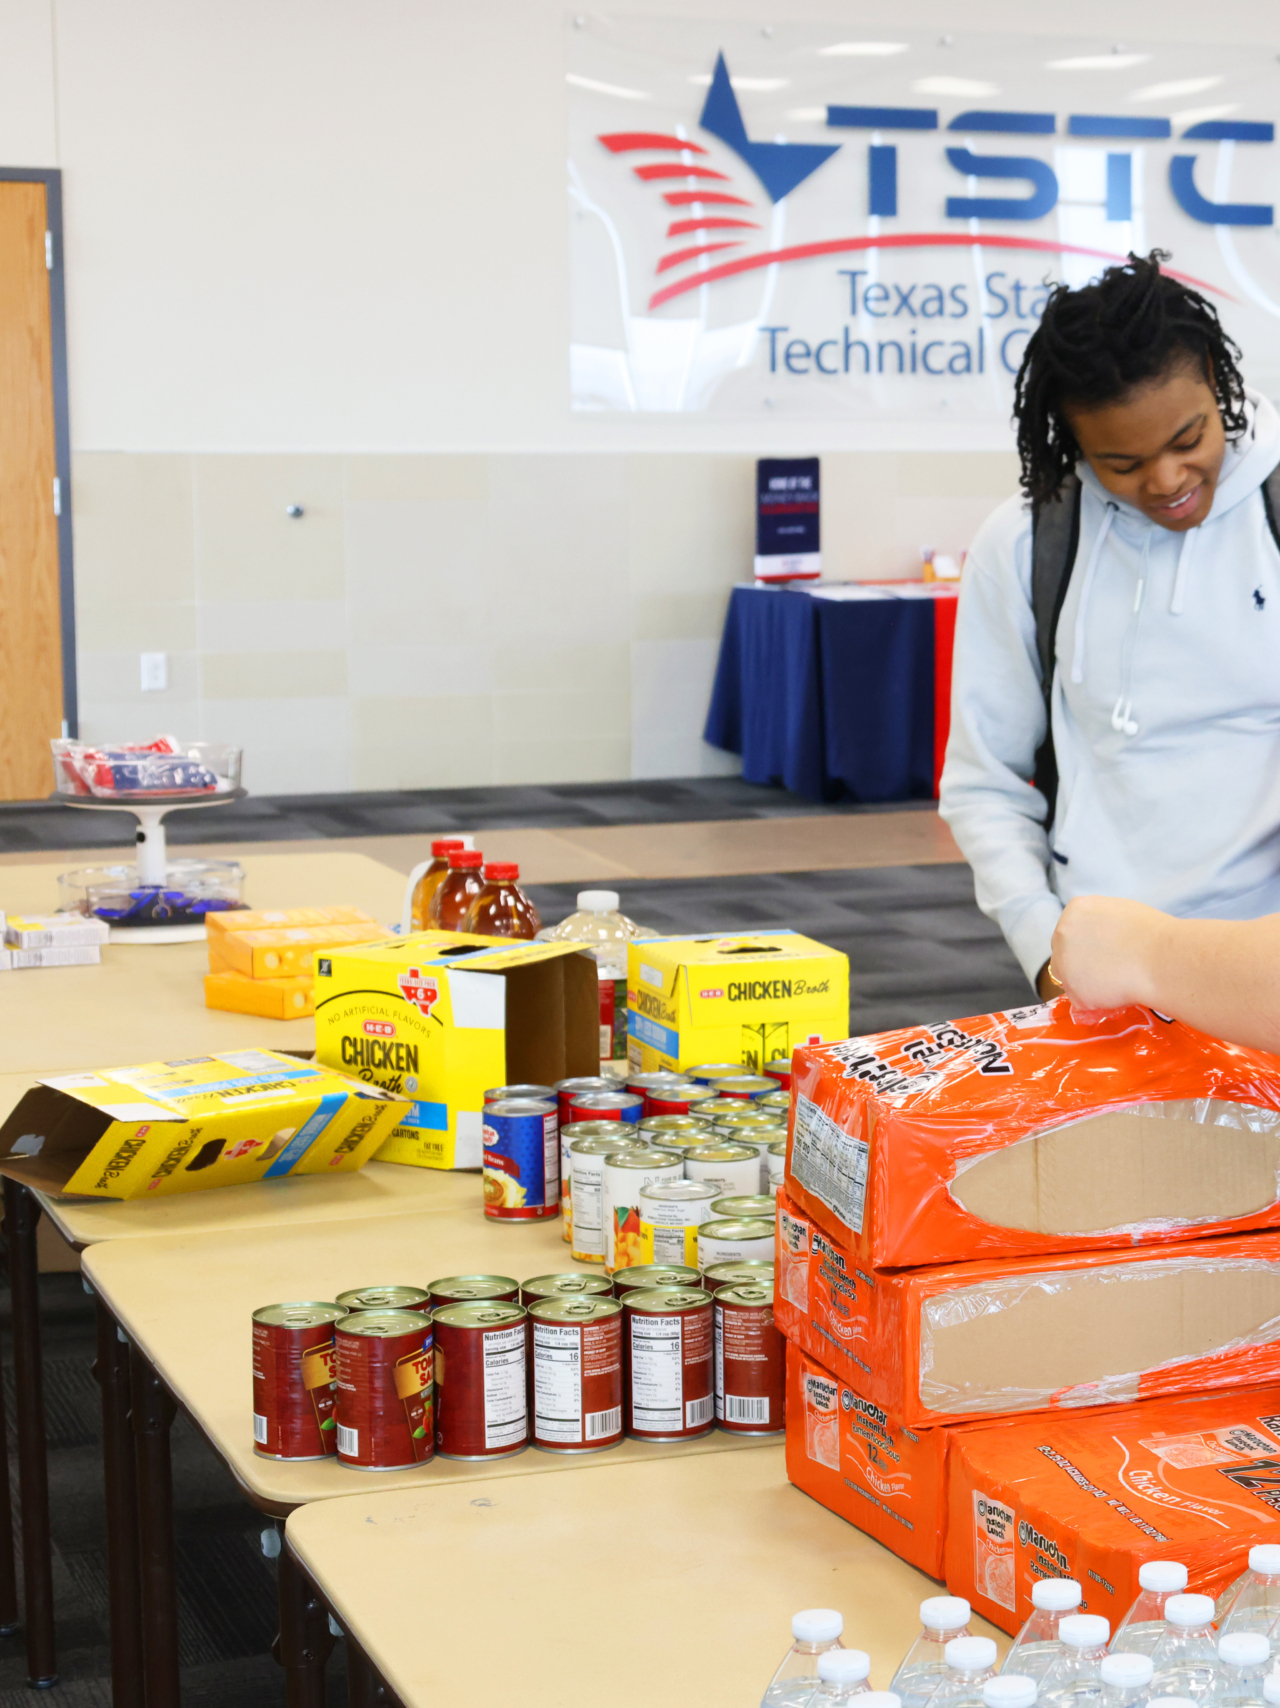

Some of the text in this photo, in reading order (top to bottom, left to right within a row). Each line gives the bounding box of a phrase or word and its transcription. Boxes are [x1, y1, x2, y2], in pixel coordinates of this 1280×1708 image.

[826, 105, 1275, 227] TSTC
[839, 270, 1050, 319] Texas Sta
[759, 327, 986, 375] Technical
[416, 988, 425, 1000] 6
[728, 979, 792, 1001] CHICKEN
[793, 979, 830, 996] Broth
[327, 1006, 431, 1038] NO ARTIFICIAL FLAVORS
[341, 1035, 419, 1074] CHICKEN
[391, 1128, 420, 1140] CARTONS
[534, 1324, 580, 1336] Nutrition Facts
[631, 1316, 680, 1326] Nutrition Facts
[484, 1326, 525, 1342] Nutrition Fact
[534, 1350, 579, 1361] Calories 16
[632, 1341, 680, 1350] Calories 16
[485, 1358, 509, 1367] Calories
[867, 1442, 878, 1465] 12
[866, 1466, 891, 1493] Chicken
[1129, 1469, 1226, 1517] Chicken Flavor
[987, 1525, 1005, 1540] Lunch
[1025, 1520, 1070, 1572] Maruchn
